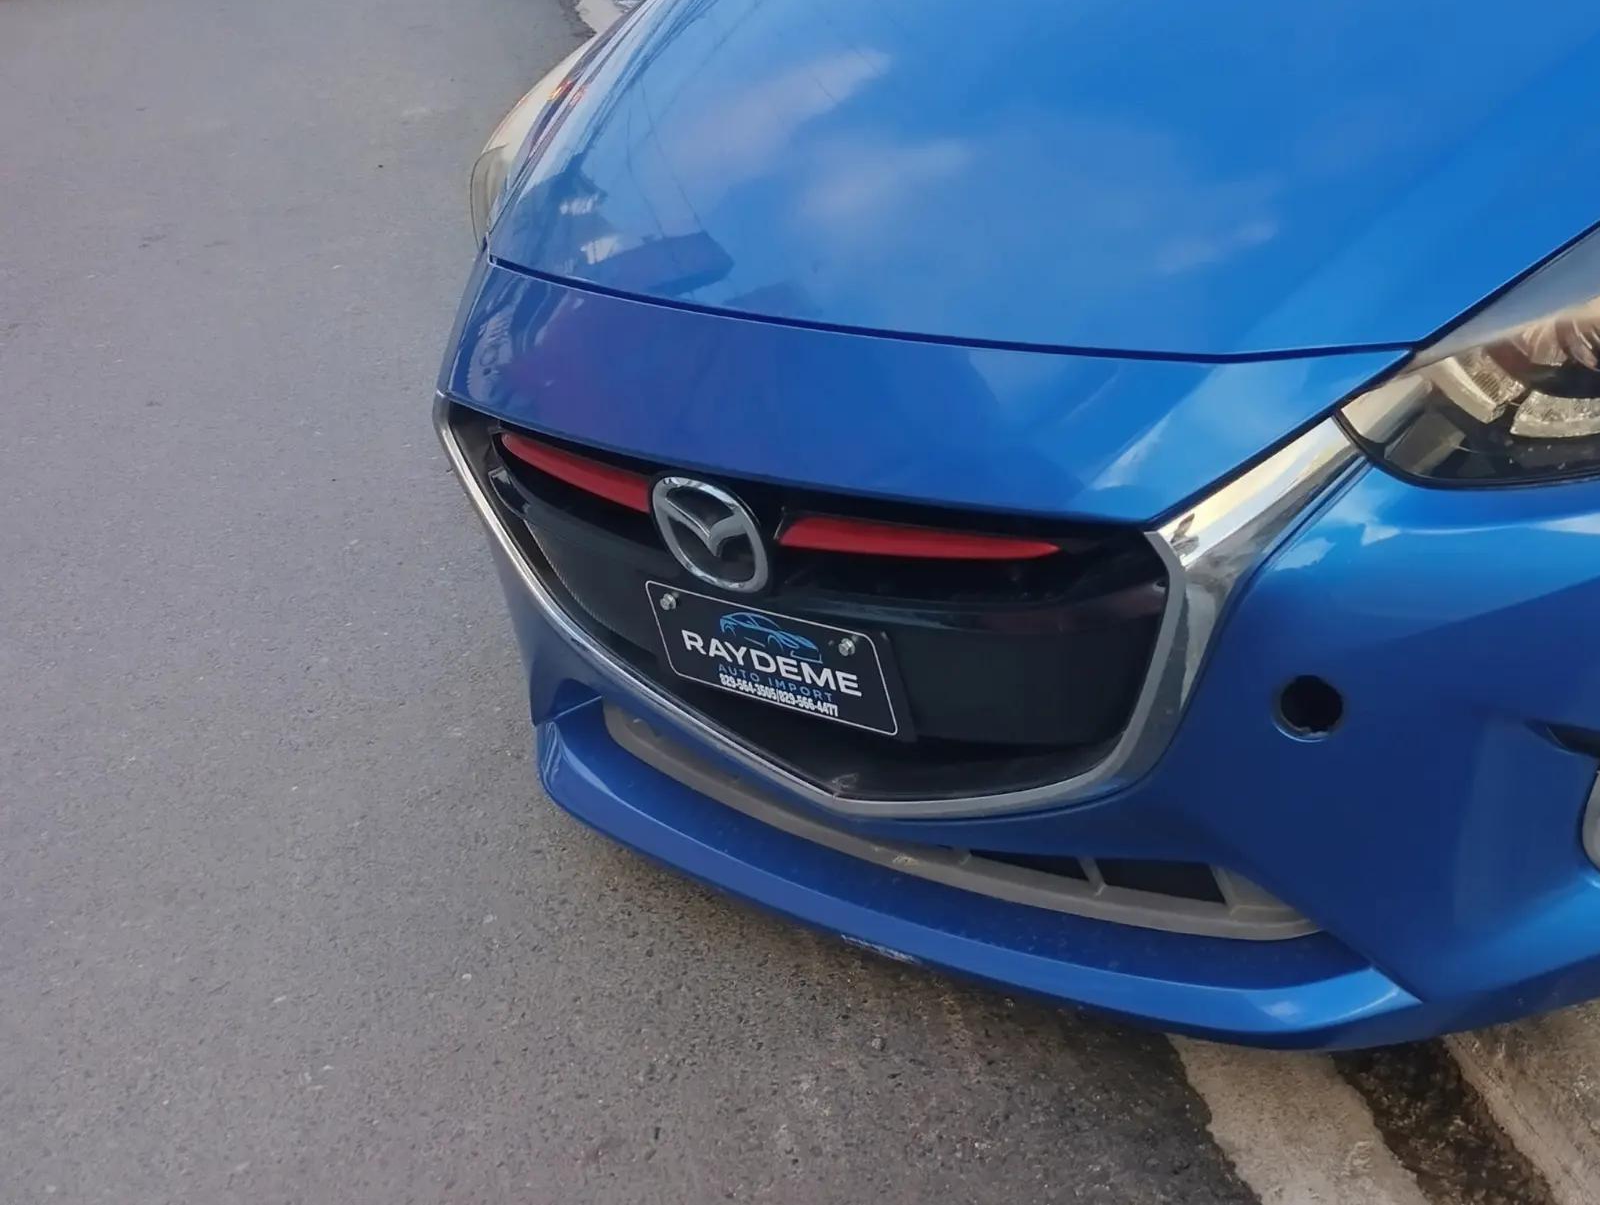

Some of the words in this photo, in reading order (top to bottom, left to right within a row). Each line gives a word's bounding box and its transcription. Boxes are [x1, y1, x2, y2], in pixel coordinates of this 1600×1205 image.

[681, 628, 862, 698] RAYDEME
[718, 663, 760, 683] AUTO
[768, 676, 834, 703] IMPORT
